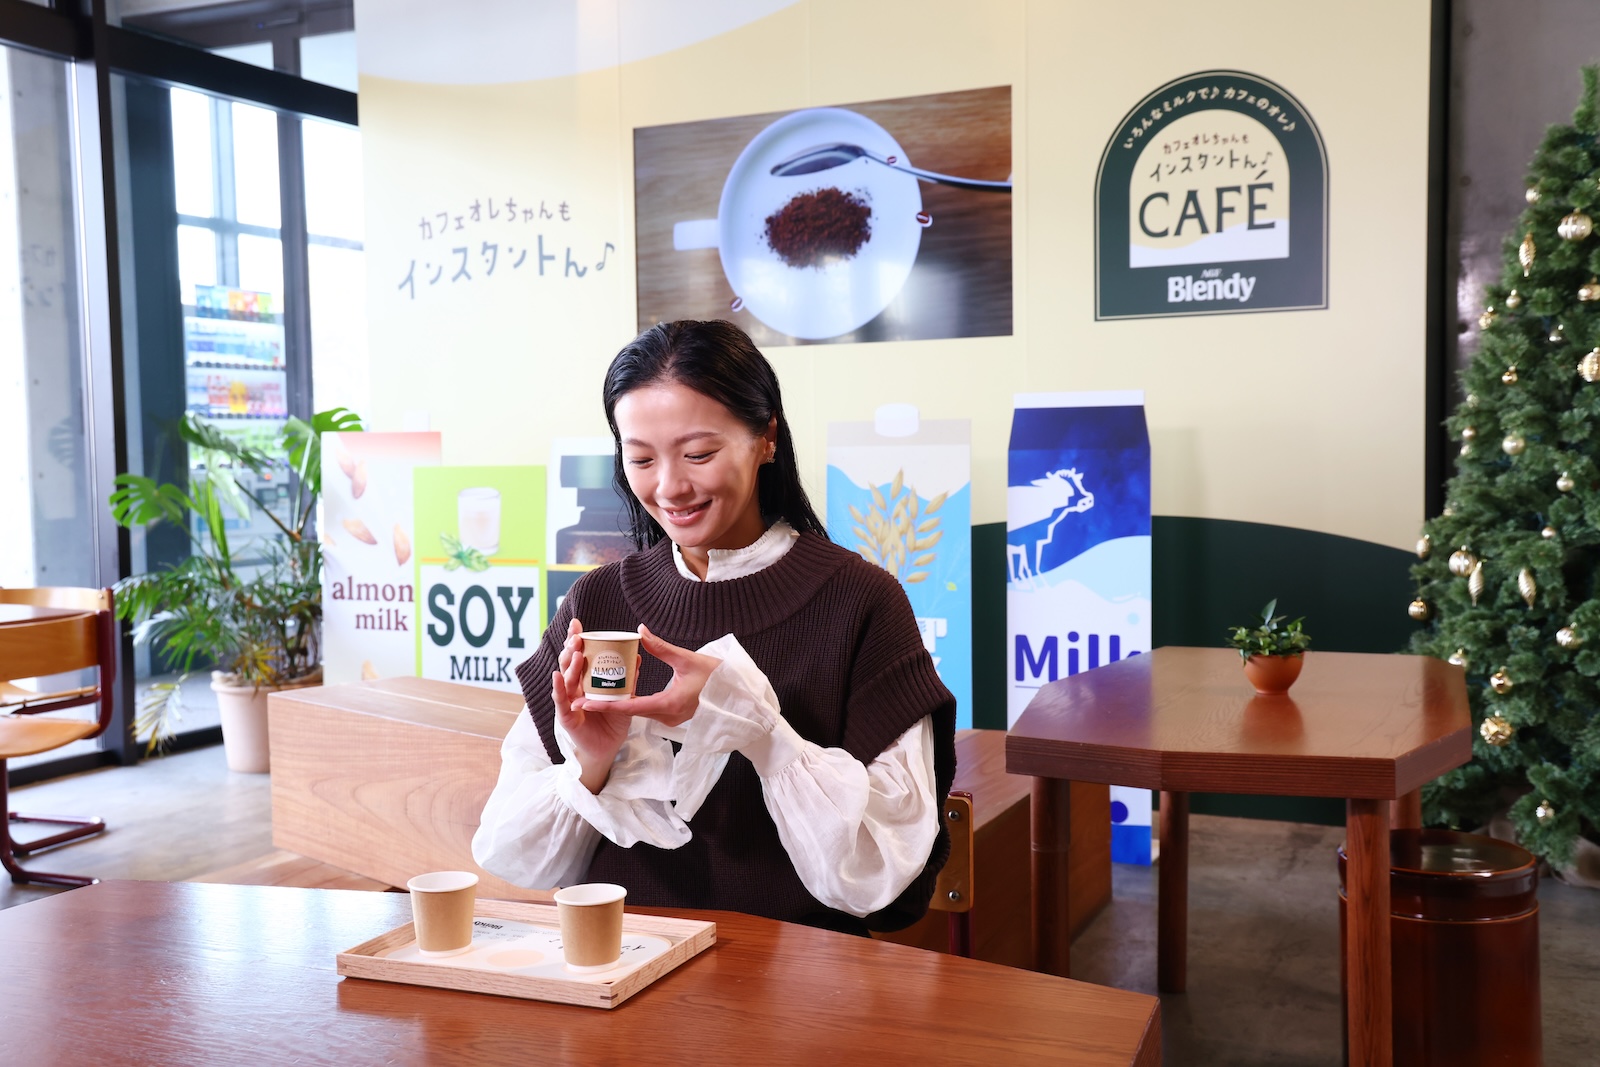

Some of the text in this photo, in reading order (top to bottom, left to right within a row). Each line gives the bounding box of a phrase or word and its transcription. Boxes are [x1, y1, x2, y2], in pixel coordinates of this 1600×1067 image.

[418, 197, 572, 240] カフェオレちゃんも
[1138, 169, 1276, 238] CAFÉ
[1167, 272, 1257, 303] Blendy
[355, 608, 409, 632] milk
[427, 583, 534, 648] SOY
[450, 655, 512, 683] MILK
[593, 667, 624, 675] ALMOND
